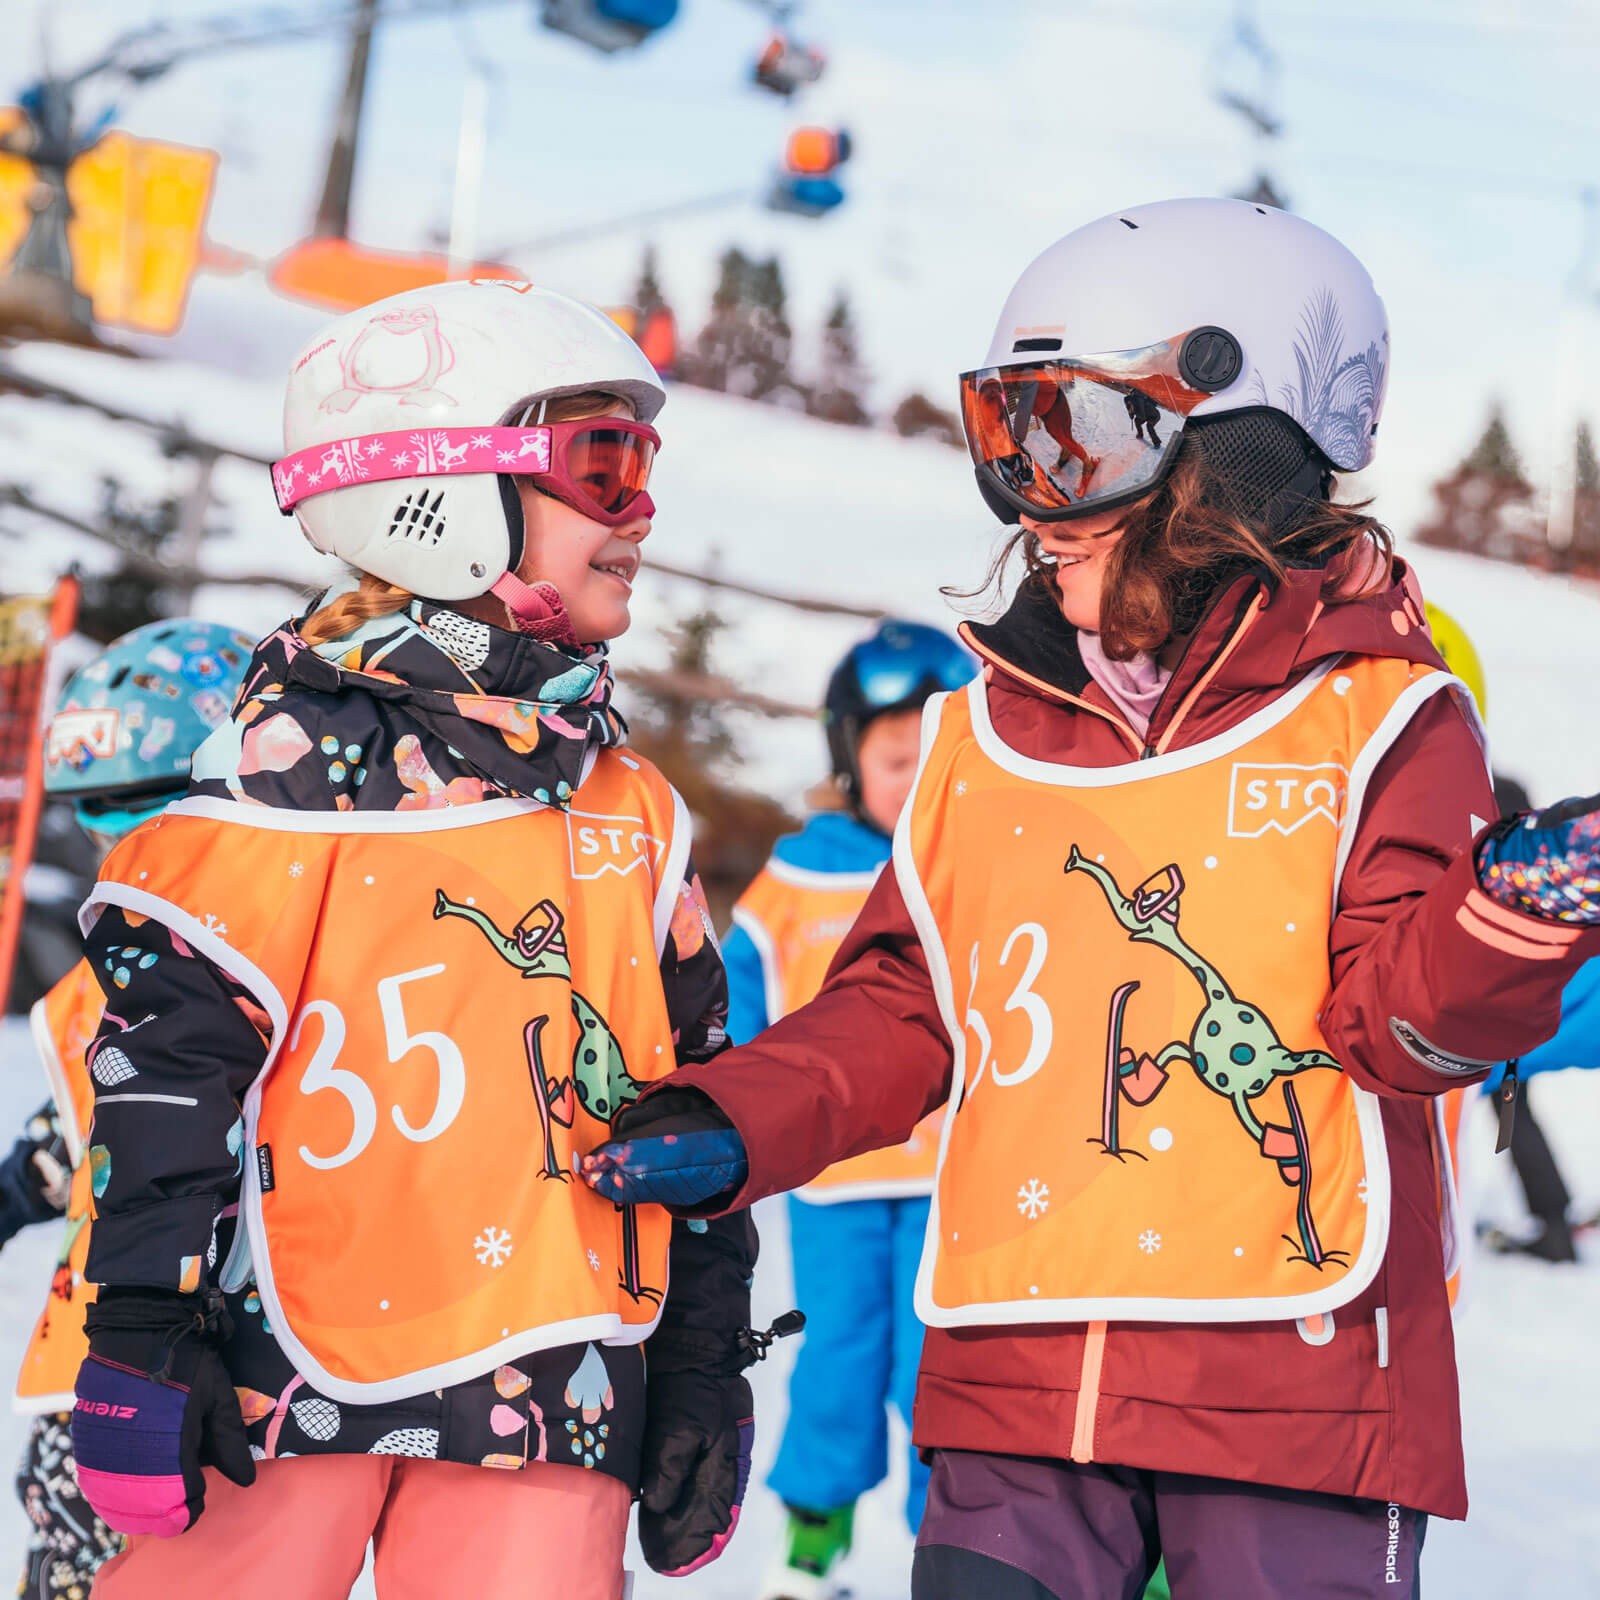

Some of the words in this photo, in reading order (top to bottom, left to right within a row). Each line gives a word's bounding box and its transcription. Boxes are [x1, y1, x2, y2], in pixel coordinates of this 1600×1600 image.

[1245, 779, 1345, 810] STO
[290, 963, 466, 1170] 35
[259, 1148, 271, 1187] FORZA
